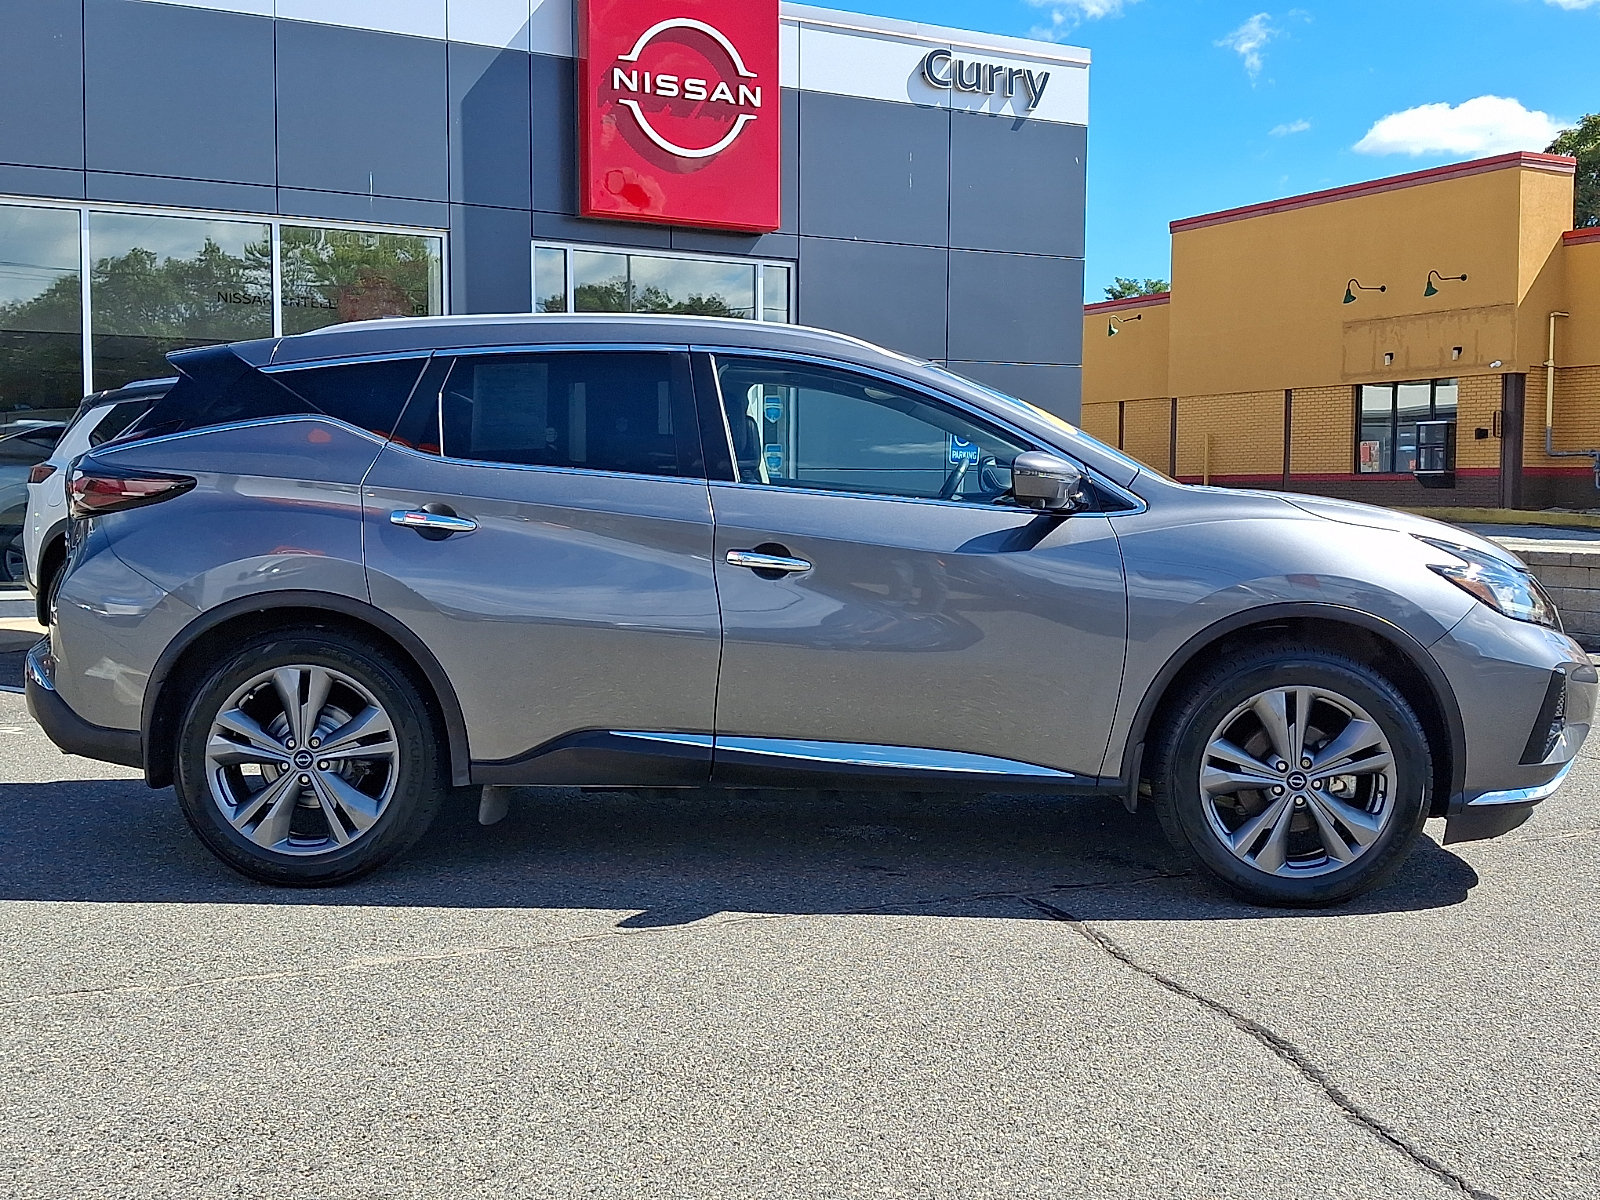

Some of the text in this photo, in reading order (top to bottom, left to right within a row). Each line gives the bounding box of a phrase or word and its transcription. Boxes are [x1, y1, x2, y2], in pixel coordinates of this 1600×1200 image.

[613, 67, 762, 108] NISSAN
[925, 48, 1051, 112] Curry
[952, 450, 977, 460] PARKING
